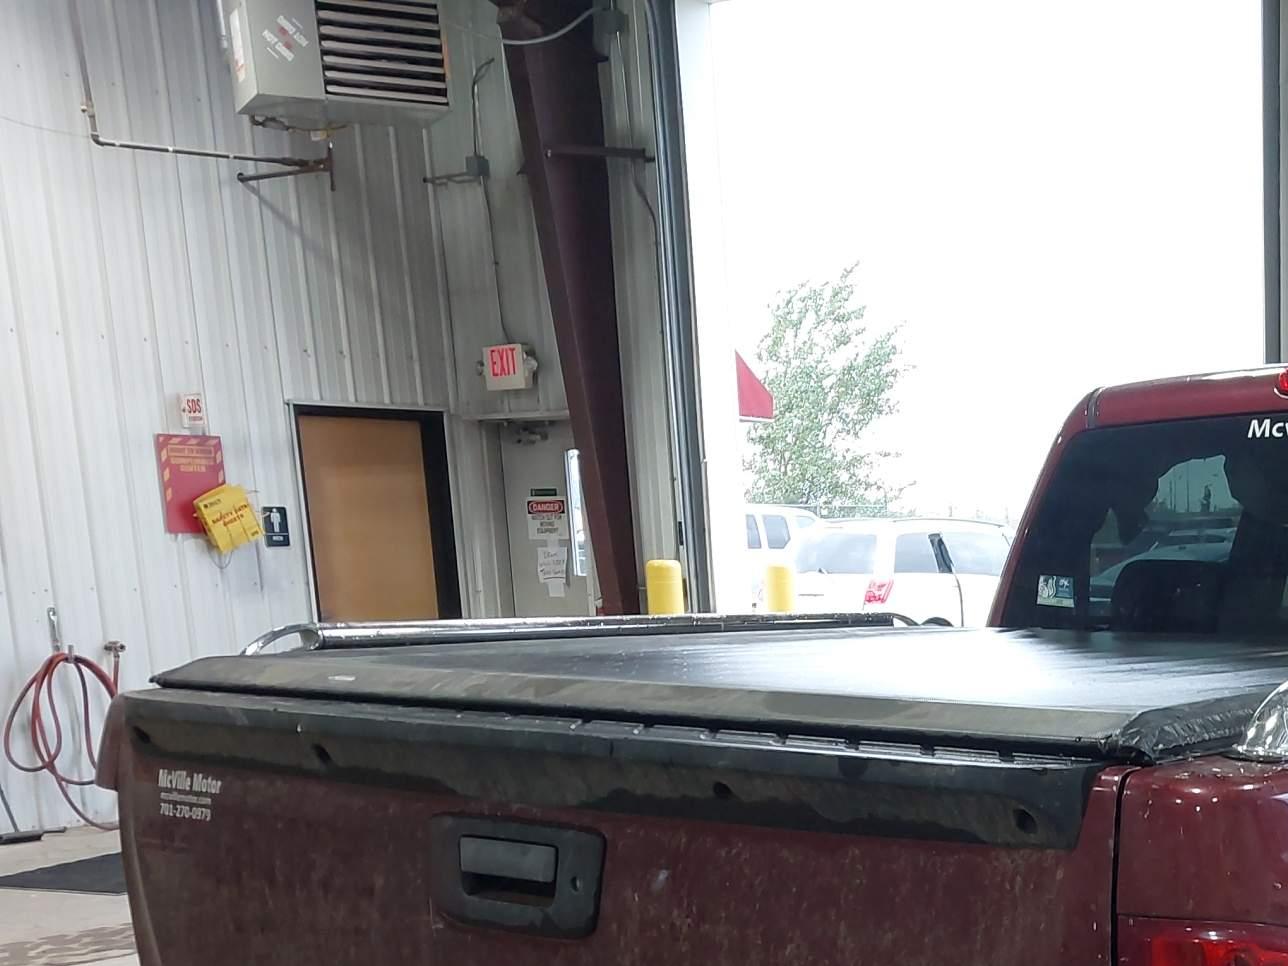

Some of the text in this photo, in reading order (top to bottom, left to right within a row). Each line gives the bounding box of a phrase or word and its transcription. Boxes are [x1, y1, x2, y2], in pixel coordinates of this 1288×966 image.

[490, 347, 516, 377] EXIT
[532, 502, 560, 512] DANGER
[192, 773, 222, 794] Motor
[160, 802, 212, 821] 701-270-0979
